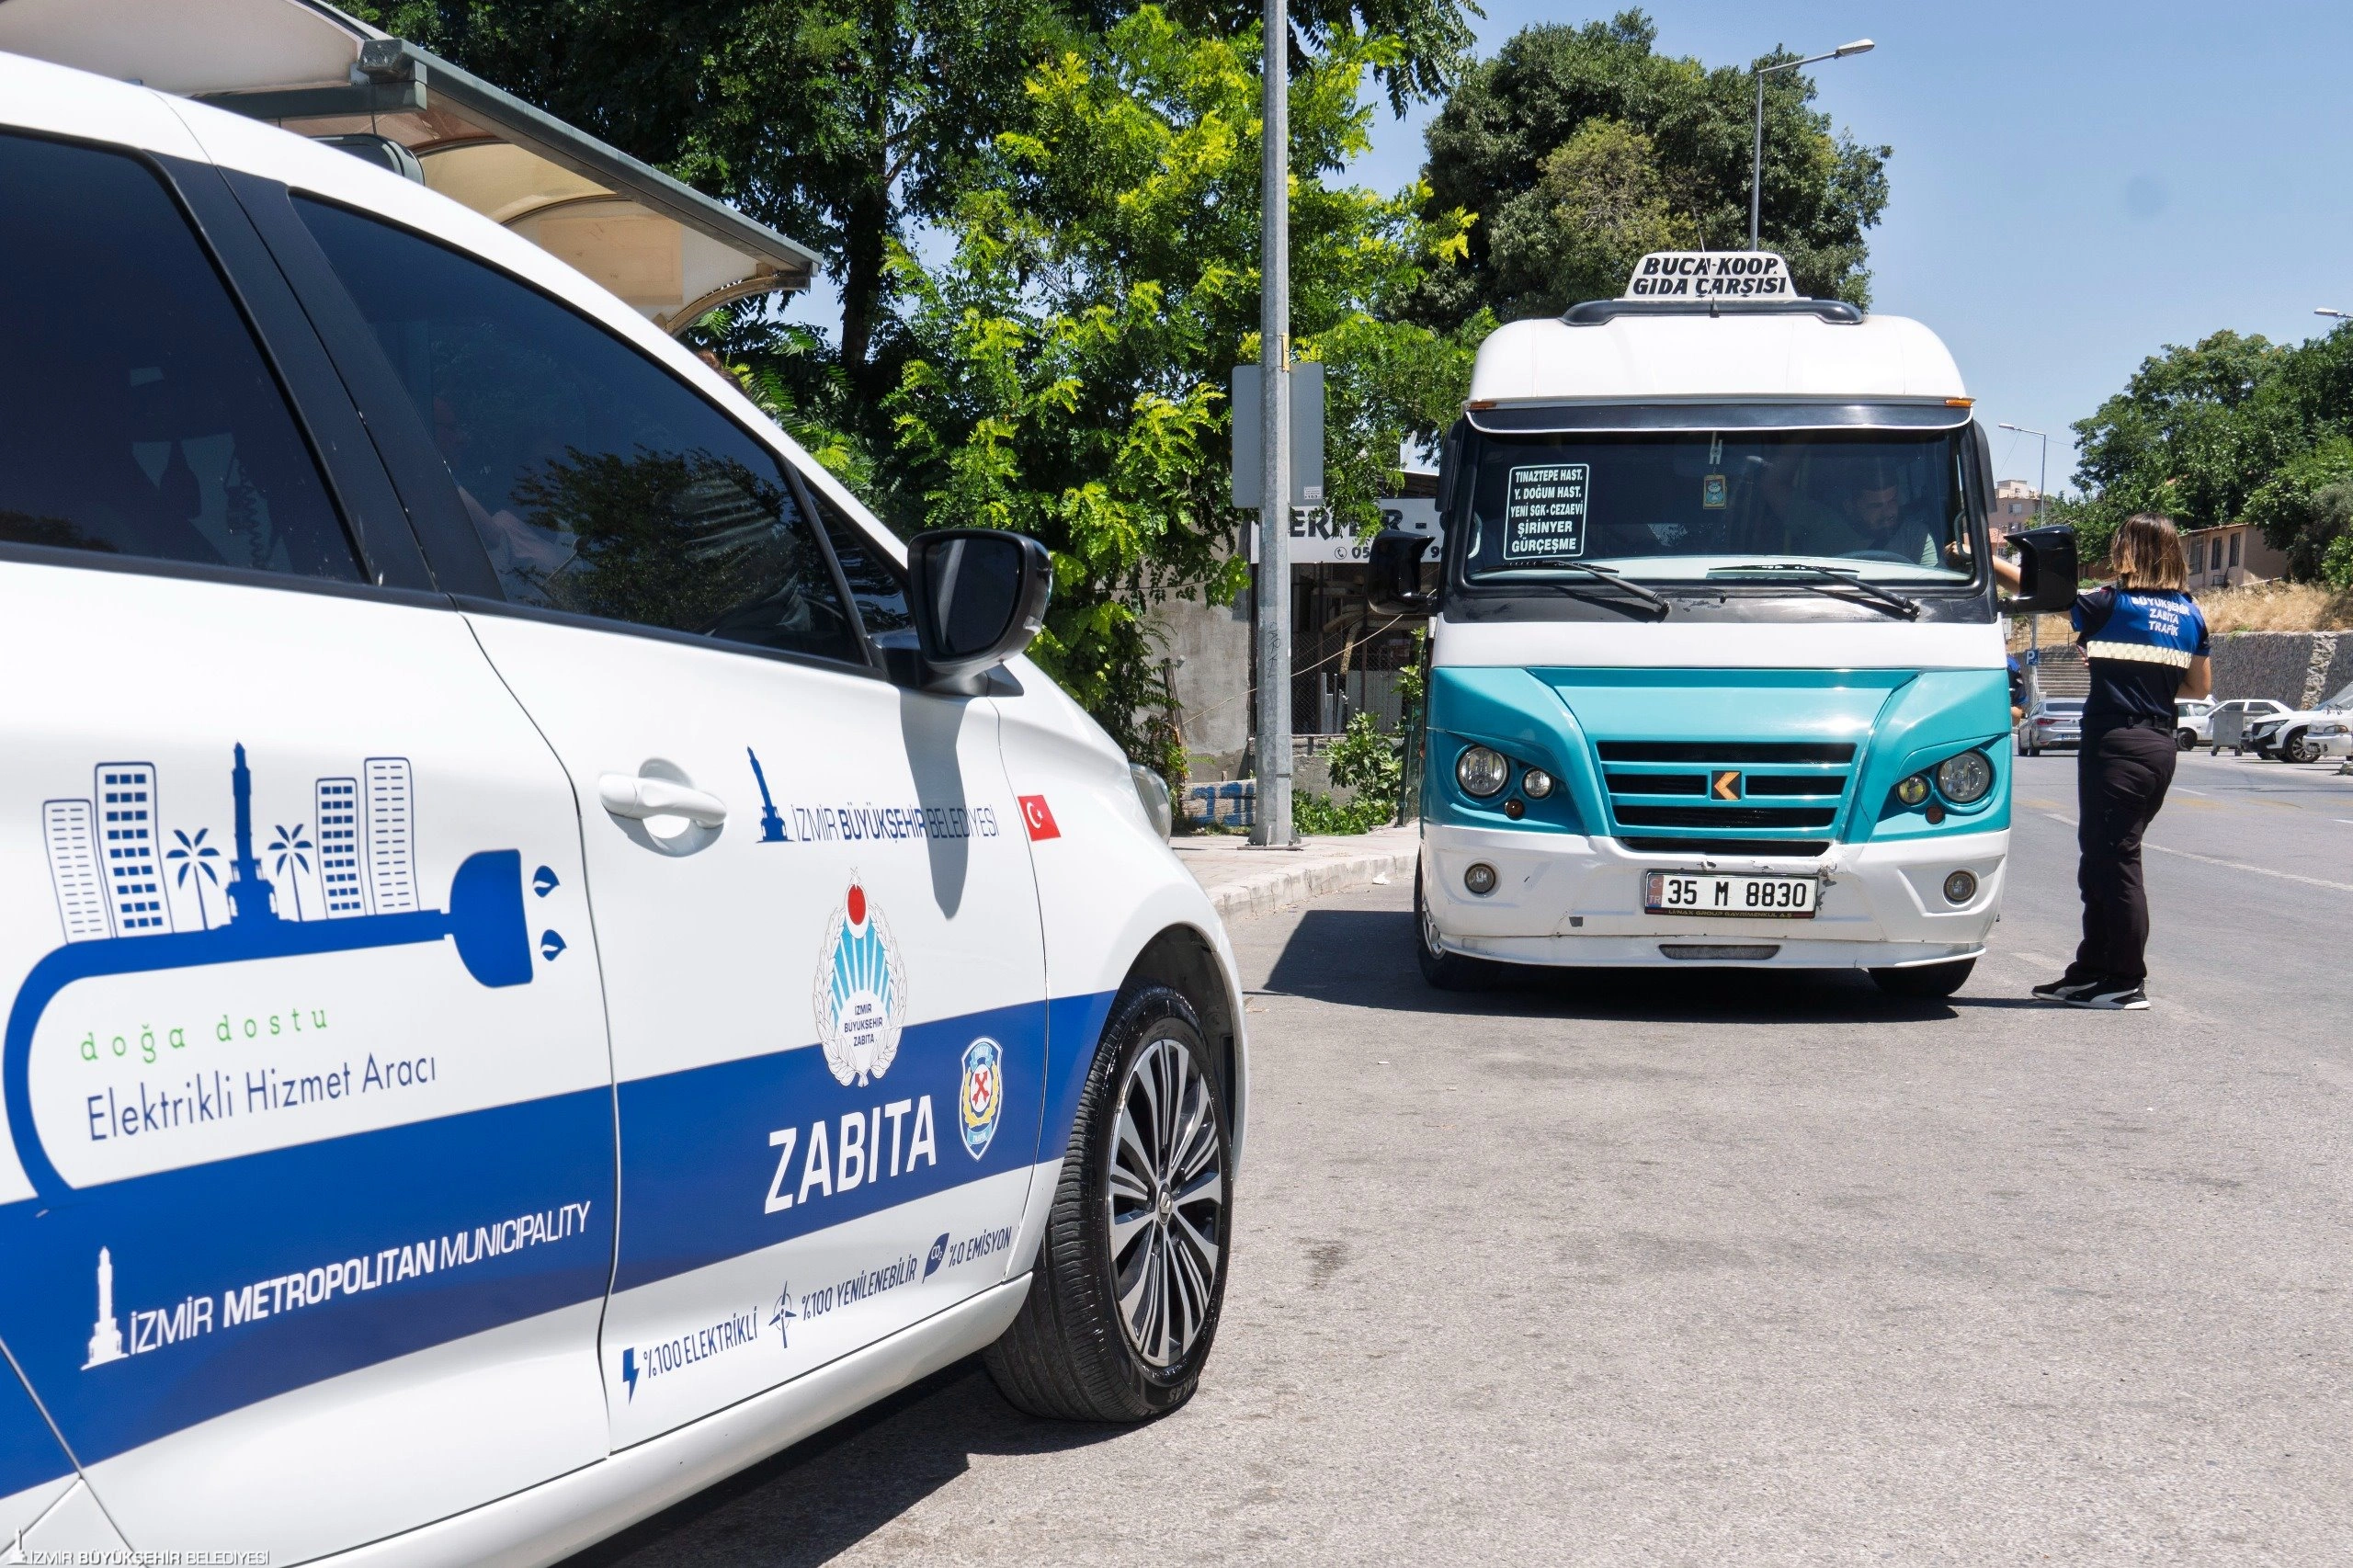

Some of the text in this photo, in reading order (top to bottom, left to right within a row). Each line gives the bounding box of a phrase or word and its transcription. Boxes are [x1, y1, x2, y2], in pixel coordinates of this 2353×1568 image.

[1632, 277, 1787, 298] GIDA ÇARŞISI
[1516, 469, 1583, 483] TINAZTEPE HAST.
[1515, 484, 1582, 500] Y. DOĞUM HAST.
[1510, 502, 1529, 517] YENİ
[1518, 519, 1573, 538] ŞİRİNYER
[1511, 537, 1577, 554] GÜRÇEŞME
[2149, 608, 2179, 625] ZABITA
[2148, 620, 2179, 637] TRAFİK
[790, 801, 1000, 843] İZMİR BÜYÜKŞEHİR BELEDİYESİ
[1649, 895, 1661, 904] TR
[1668, 880, 1807, 907] 35 M 8830
[80, 1007, 328, 1063] doğa dostu
[853, 1033, 875, 1047] ZABITA
[87, 1052, 436, 1142] Elektrikli Hizmet Aracı
[764, 1094, 937, 1215] ZABITA
[948, 1226, 1012, 1268] %0 EMİSYON
[129, 1200, 591, 1355] İZMİR METROPOLITAN MUNICIPALITY
[801, 1254, 917, 1321] %100 YENİLENEBİLİR
[643, 1305, 757, 1379] %100 ELEKTRİKLİ
